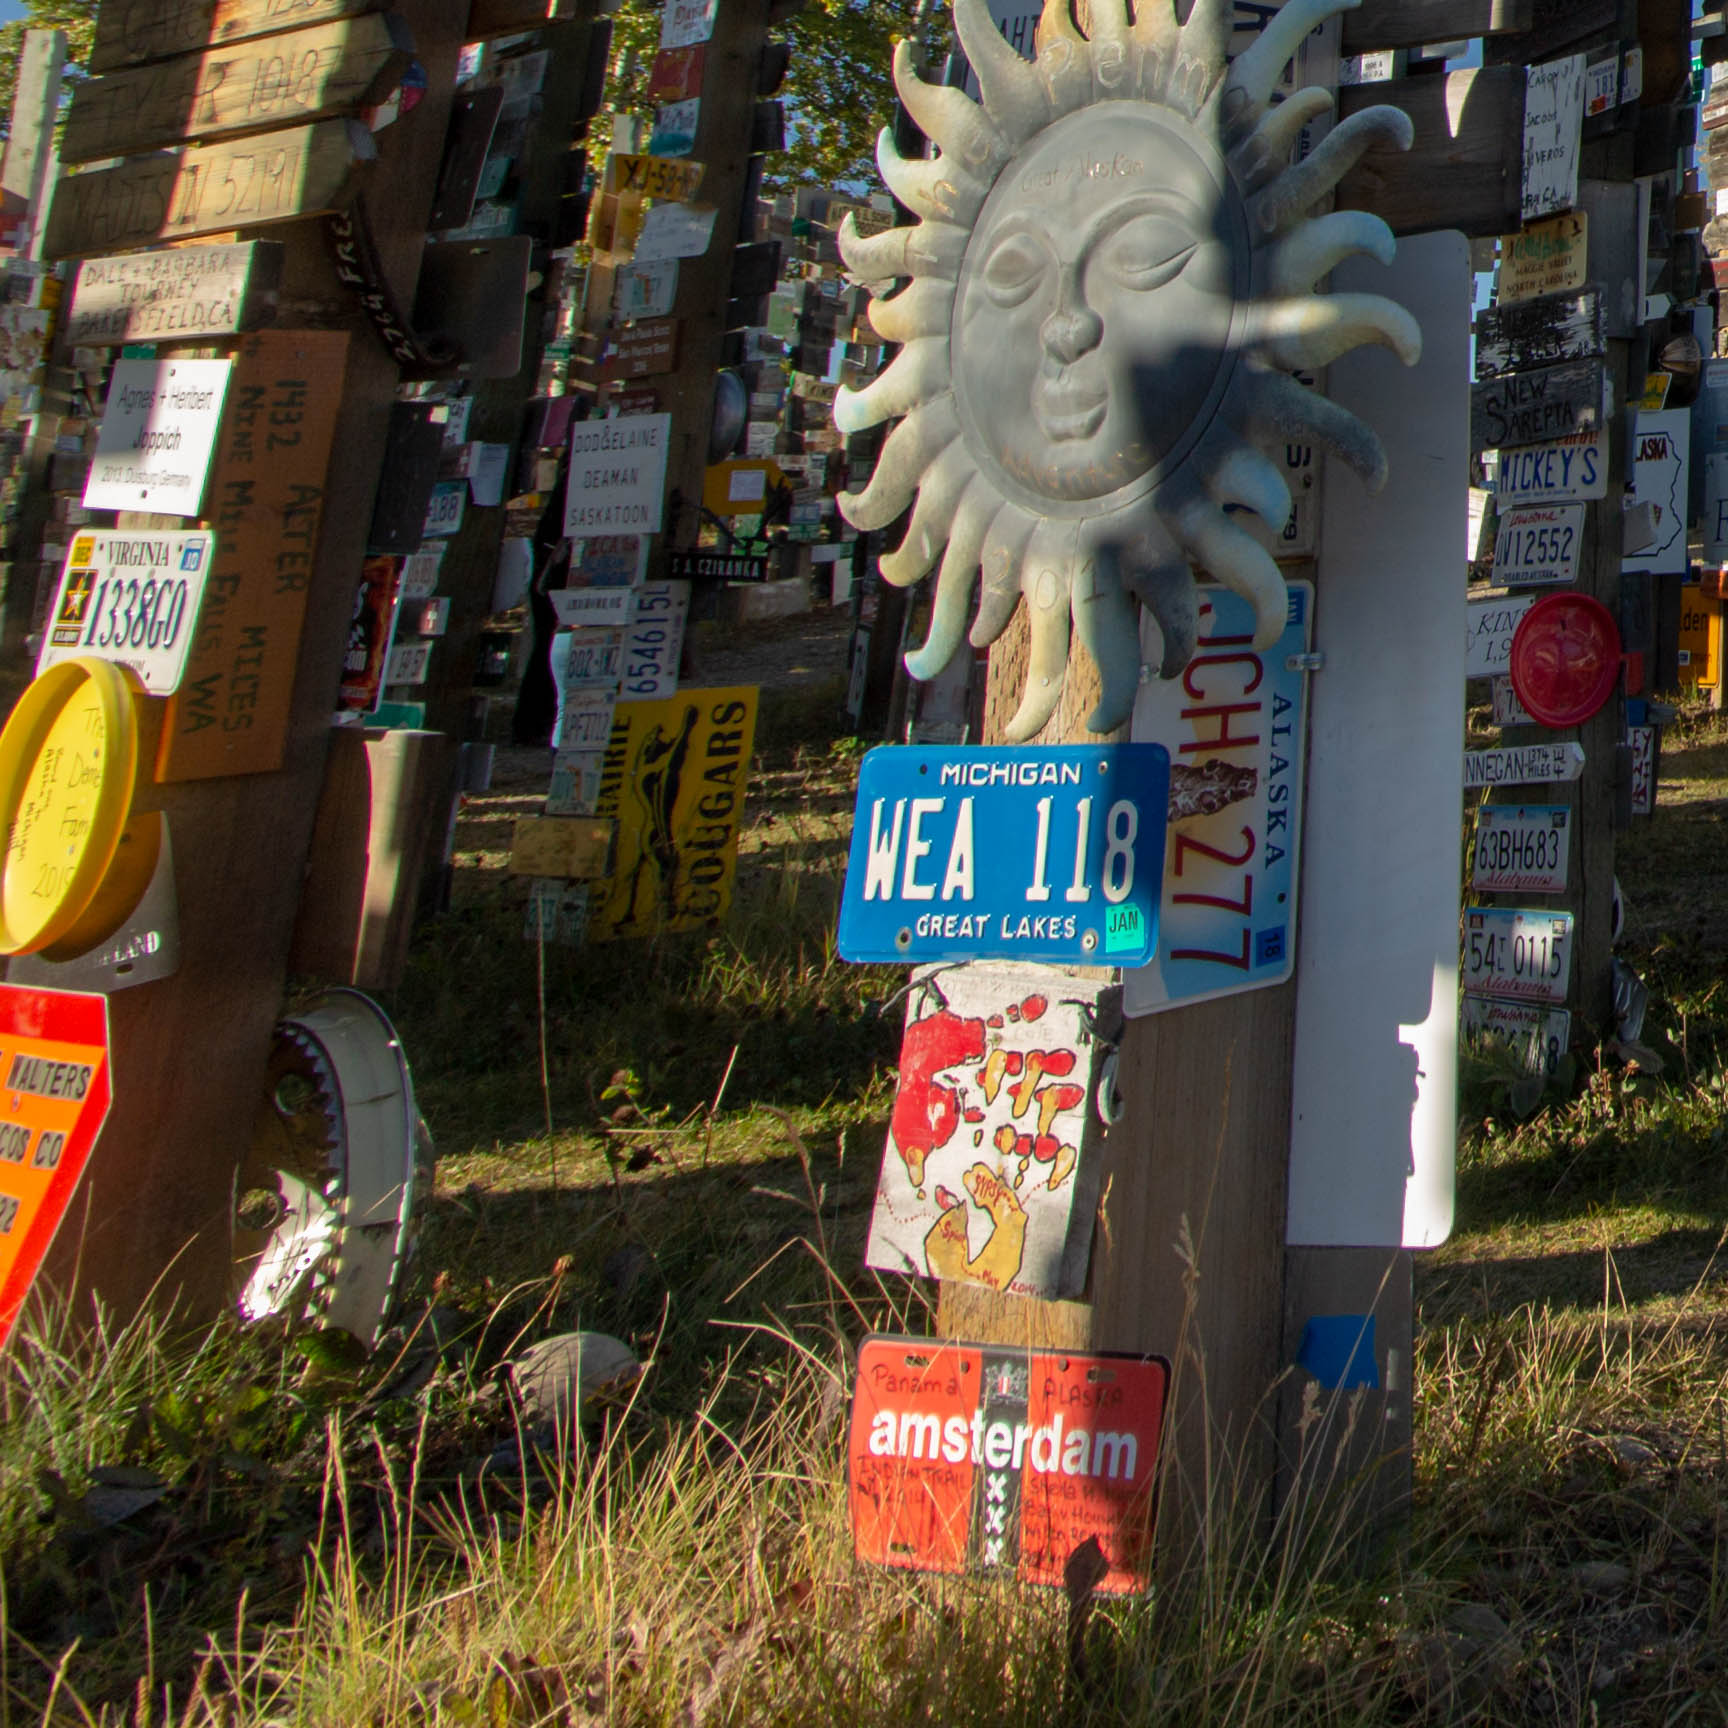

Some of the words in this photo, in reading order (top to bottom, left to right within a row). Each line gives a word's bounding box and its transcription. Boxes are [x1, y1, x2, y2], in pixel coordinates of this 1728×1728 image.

[108, 540, 170, 568] VIRGINIA
[940, 763, 1081, 786] MICHIGAN
[1261, 692, 1294, 872] ALASKA
[864, 797, 974, 902] WEA
[1026, 796, 1139, 904] 118
[916, 914, 990, 938] GREAT
[1001, 916, 1077, 941] LAKES
[869, 1408, 1137, 1480] amsterdam
